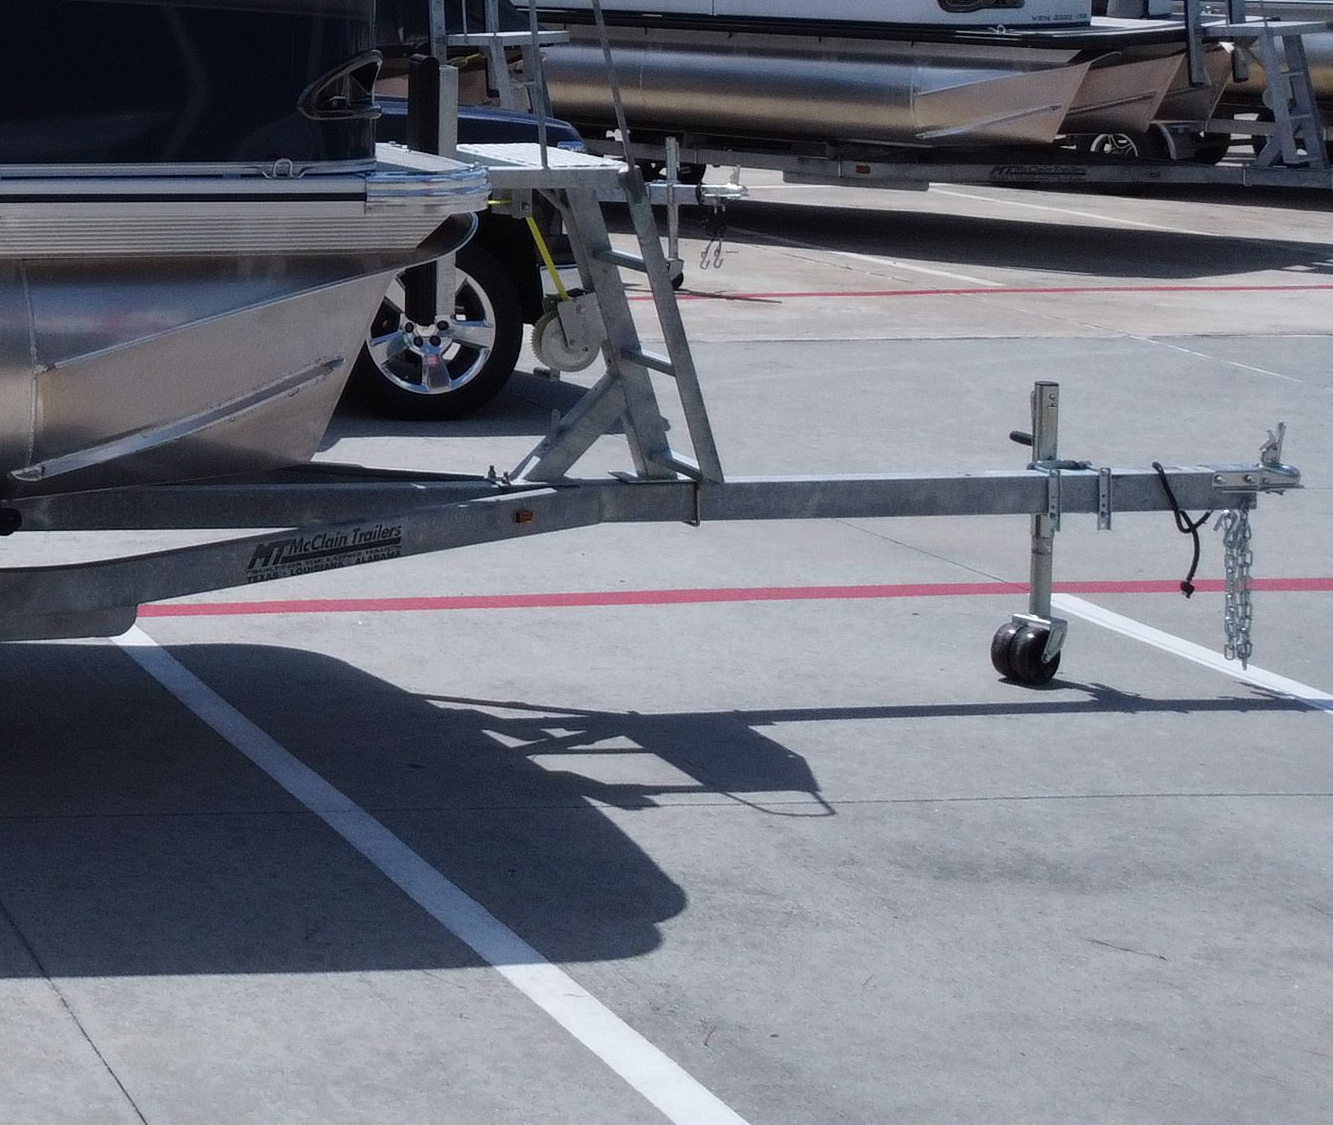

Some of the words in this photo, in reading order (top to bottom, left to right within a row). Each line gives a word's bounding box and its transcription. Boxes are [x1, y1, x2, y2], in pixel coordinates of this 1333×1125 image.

[288, 533, 348, 555] McClain
[352, 524, 402, 545] Trailers
[290, 561, 344, 576] LOUISIANA
[355, 550, 402, 565] ALABAMA
